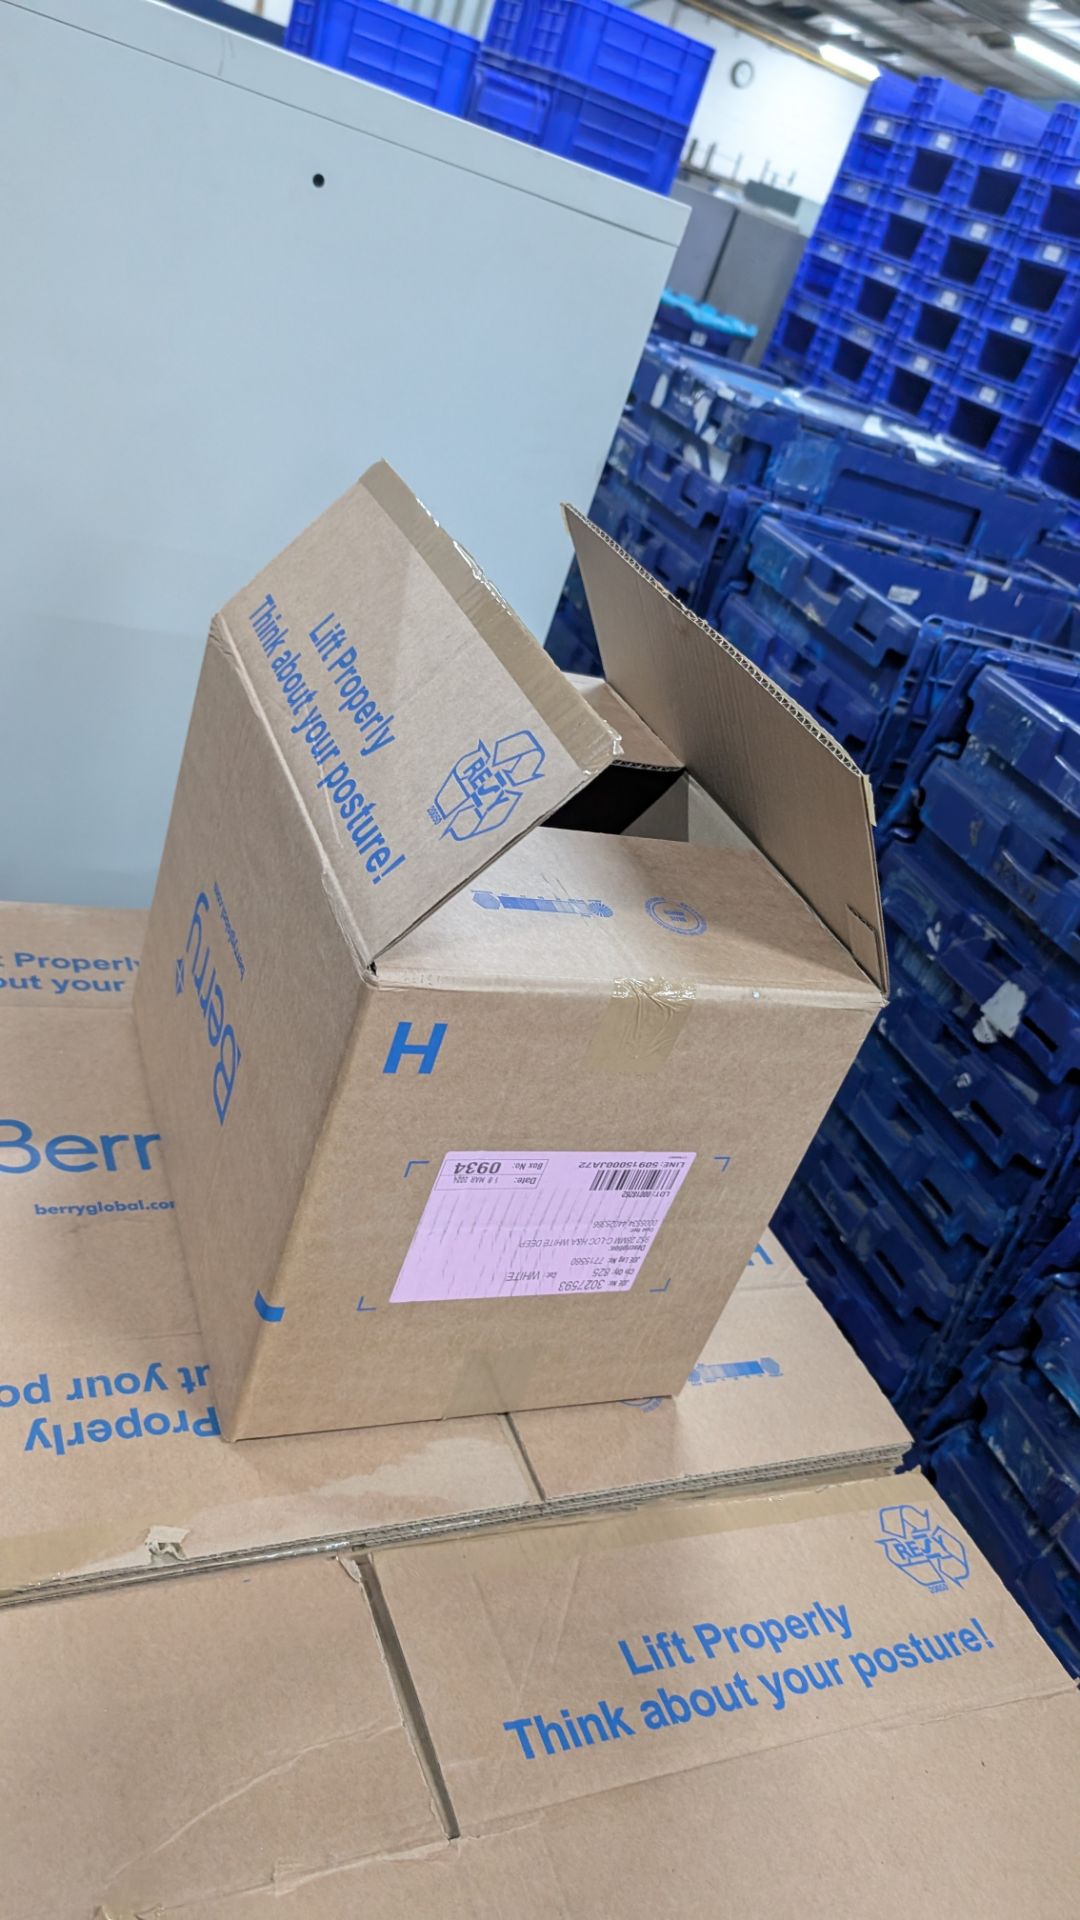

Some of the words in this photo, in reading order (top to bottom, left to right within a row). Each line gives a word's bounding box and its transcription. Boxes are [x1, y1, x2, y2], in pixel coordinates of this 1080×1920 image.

[249, 594, 289, 658] Think
[308, 612, 347, 662] Lift
[271, 650, 318, 716] about
[327, 646, 396, 756] Properly
[291, 706, 341, 765] your
[463, 757, 510, 812] RESY
[317, 761, 406, 885] posture!
[14, 952, 140, 973] Properl
[51, 977, 125, 994] your
[383, 1021, 448, 1074] H
[0, 1116, 161, 1173] Berr
[453, 1161, 502, 1173] 0934
[469, 1175, 485, 1184] MAR
[511, 1162, 525, 1170] No:
[513, 1176, 536, 1184] Date:
[34, 1200, 175, 1216] berryglobal.co
[518, 1239, 542, 1247] DEEP
[542, 1238, 570, 1247] WHITE
[505, 1270, 541, 1281] WHITE
[557, 1278, 605, 1291] 3027593
[67, 1362, 168, 1400] your
[24, 1407, 221, 1455] Properly
[893, 1534, 952, 1561] RESY
[618, 1631, 695, 1676] Lift
[693, 1601, 853, 1659] Properly
[503, 1700, 636, 1760] Think
[639, 1672, 758, 1730] about
[757, 1656, 841, 1711] your
[850, 1617, 994, 1689] posture!
